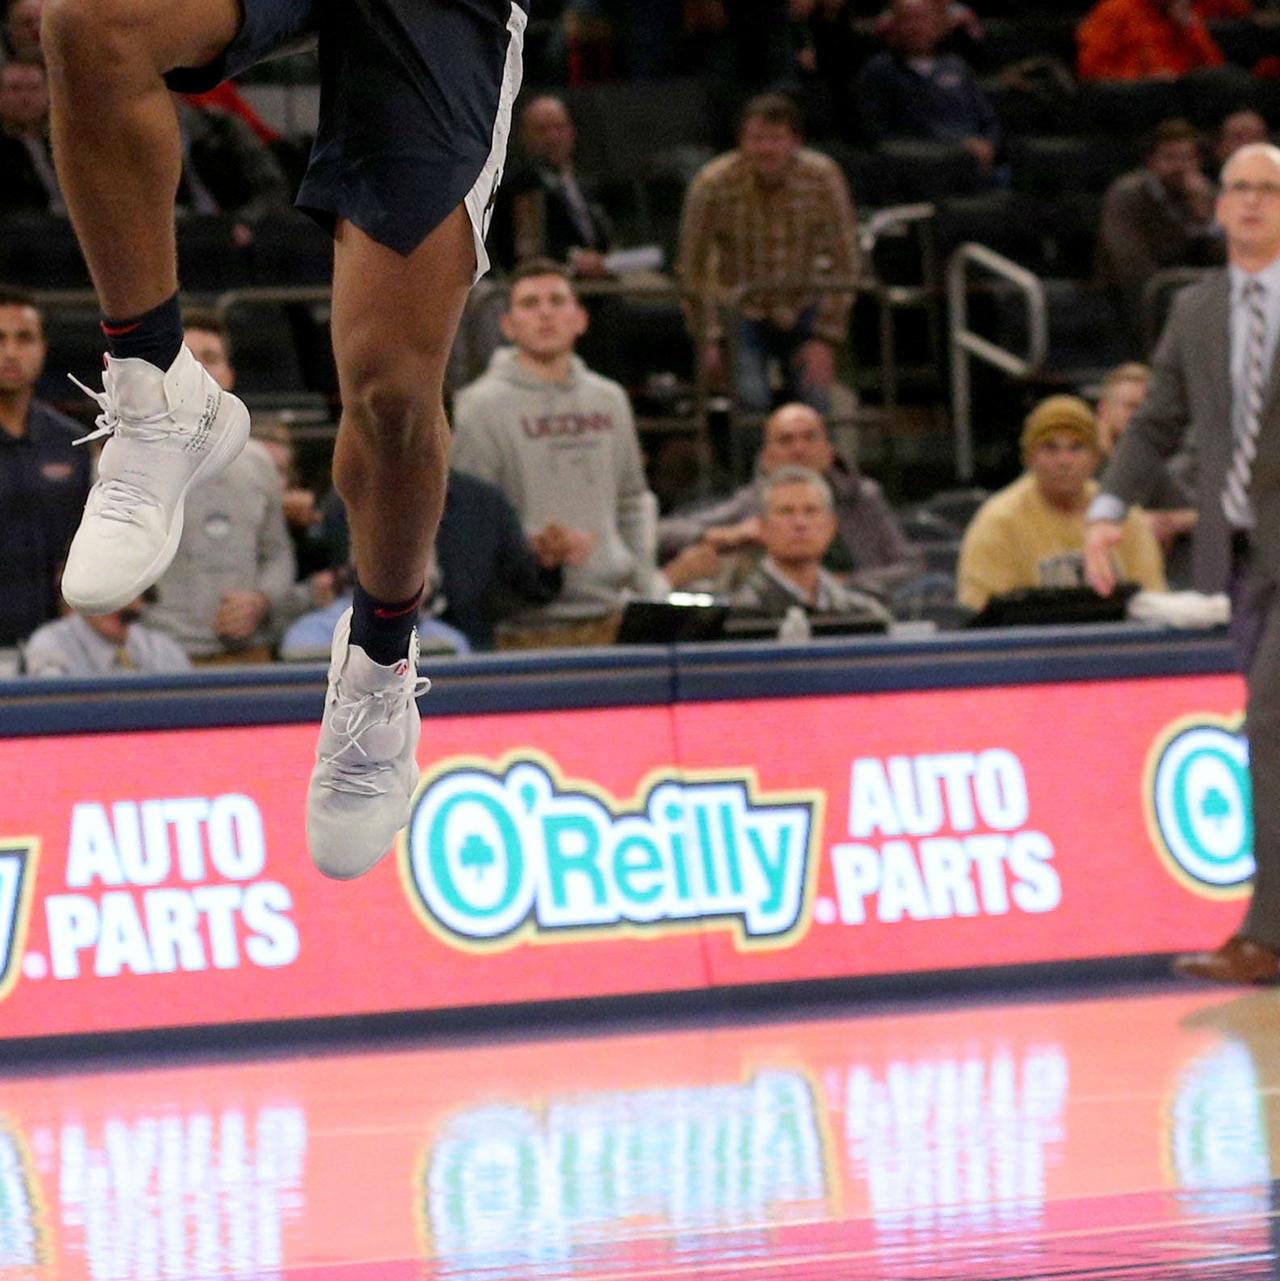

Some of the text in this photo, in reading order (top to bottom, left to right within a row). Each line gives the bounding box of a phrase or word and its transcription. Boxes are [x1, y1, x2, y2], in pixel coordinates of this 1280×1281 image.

[66, 793, 264, 888] AUTO
[848, 748, 1030, 838] AUTO
[410, 762, 811, 937] O'Reilly
[832, 831, 1062, 924] PARTS
[45, 885, 301, 980] PARTS
